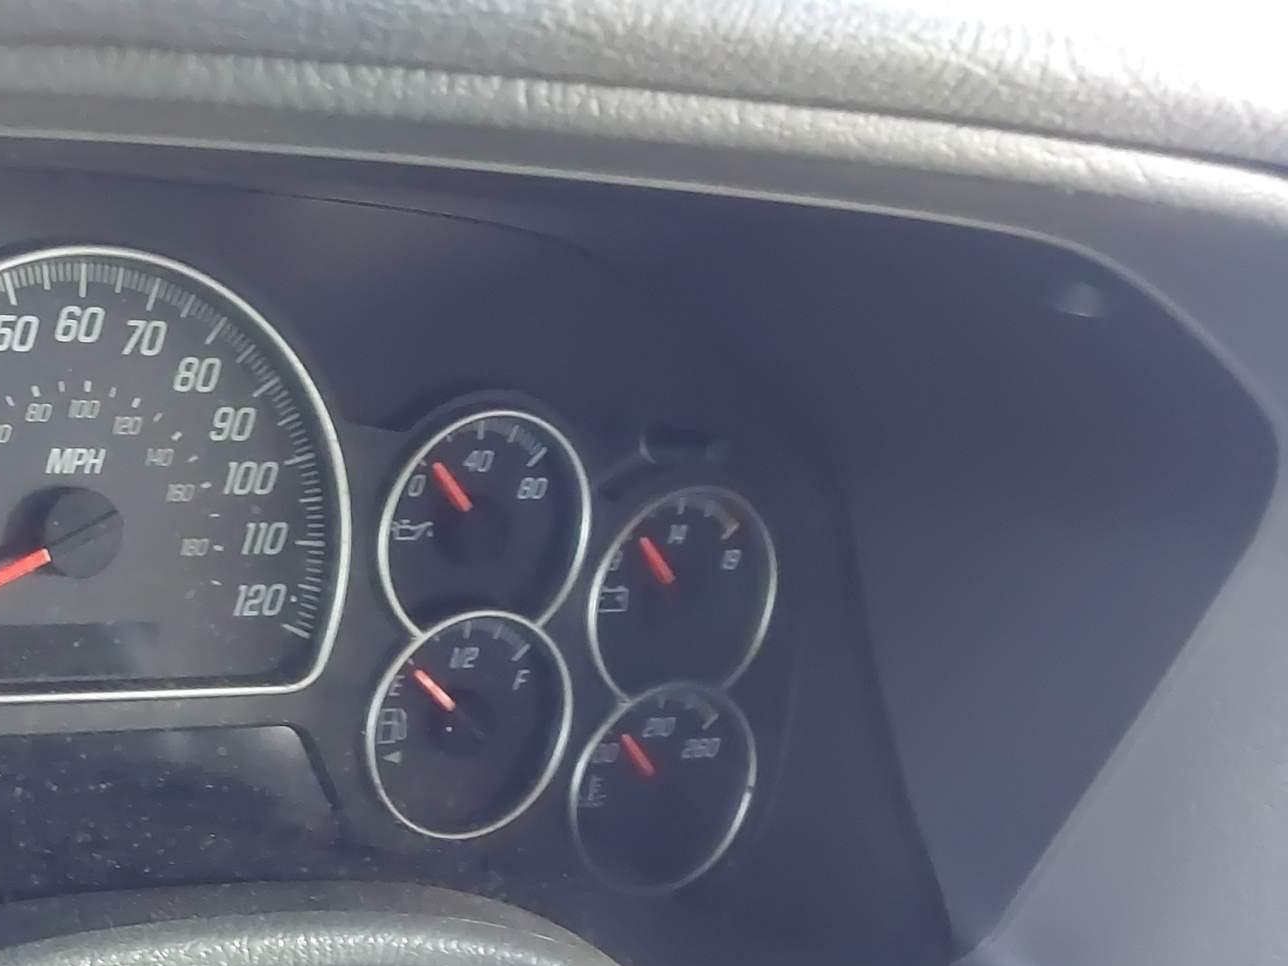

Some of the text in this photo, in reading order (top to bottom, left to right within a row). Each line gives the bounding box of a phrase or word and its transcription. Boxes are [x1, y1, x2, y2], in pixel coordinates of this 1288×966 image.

[54, 306, 105, 343] 60
[122, 321, 167, 356] 70
[173, 357, 222, 393] 80
[25, 403, 53, 422] 80
[68, 400, 100, 419] 100
[113, 416, 142, 435] 120
[209, 407, 256, 442] 90
[45, 449, 106, 474] MPH
[464, 450, 495, 472] 40
[223, 462, 279, 496] 100
[408, 474, 426, 497] 0
[241, 522, 288, 555] 110
[233, 584, 286, 617] 120
[389, 675, 406, 696] E
[513, 670, 530, 690] F
